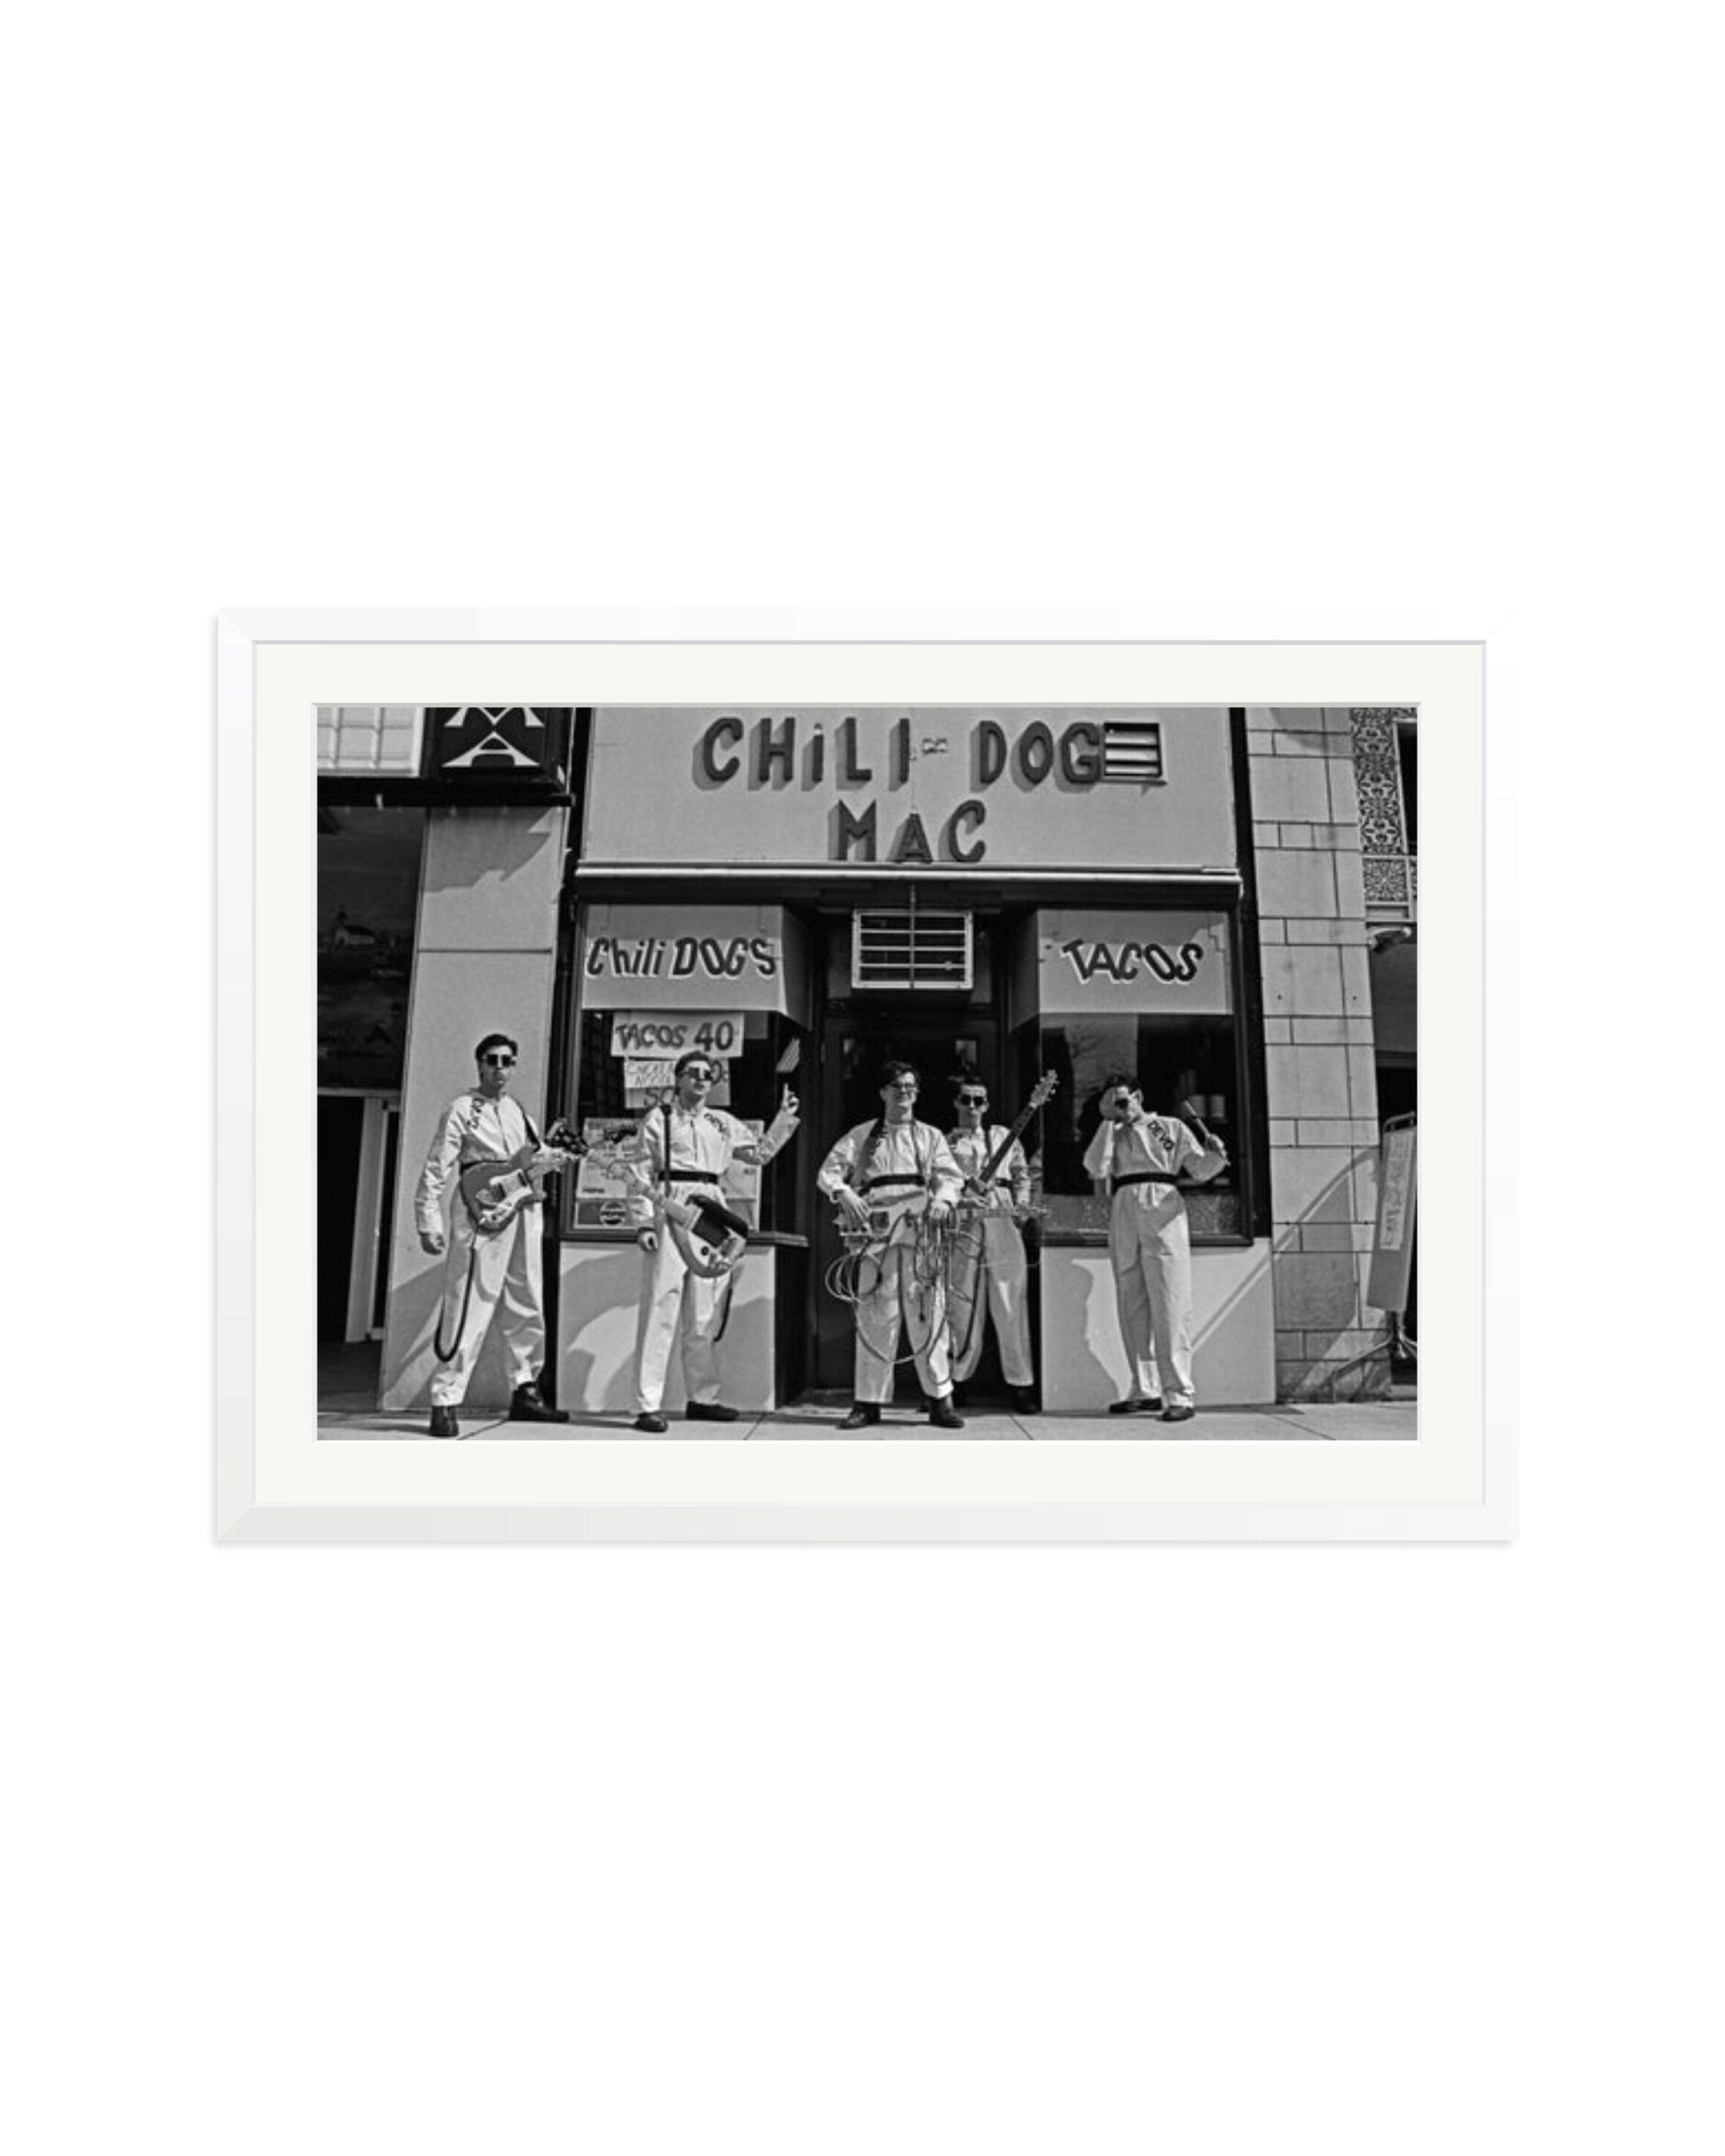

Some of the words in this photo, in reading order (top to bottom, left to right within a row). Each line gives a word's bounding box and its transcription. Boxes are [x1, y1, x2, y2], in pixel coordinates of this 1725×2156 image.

[971, 720, 1102, 793] DOG
[829, 797, 986, 864] MAC
[671, 937, 778, 979] DOGS
[1061, 939, 1203, 984] TACOS
[615, 1022, 687, 1050] TACOS
